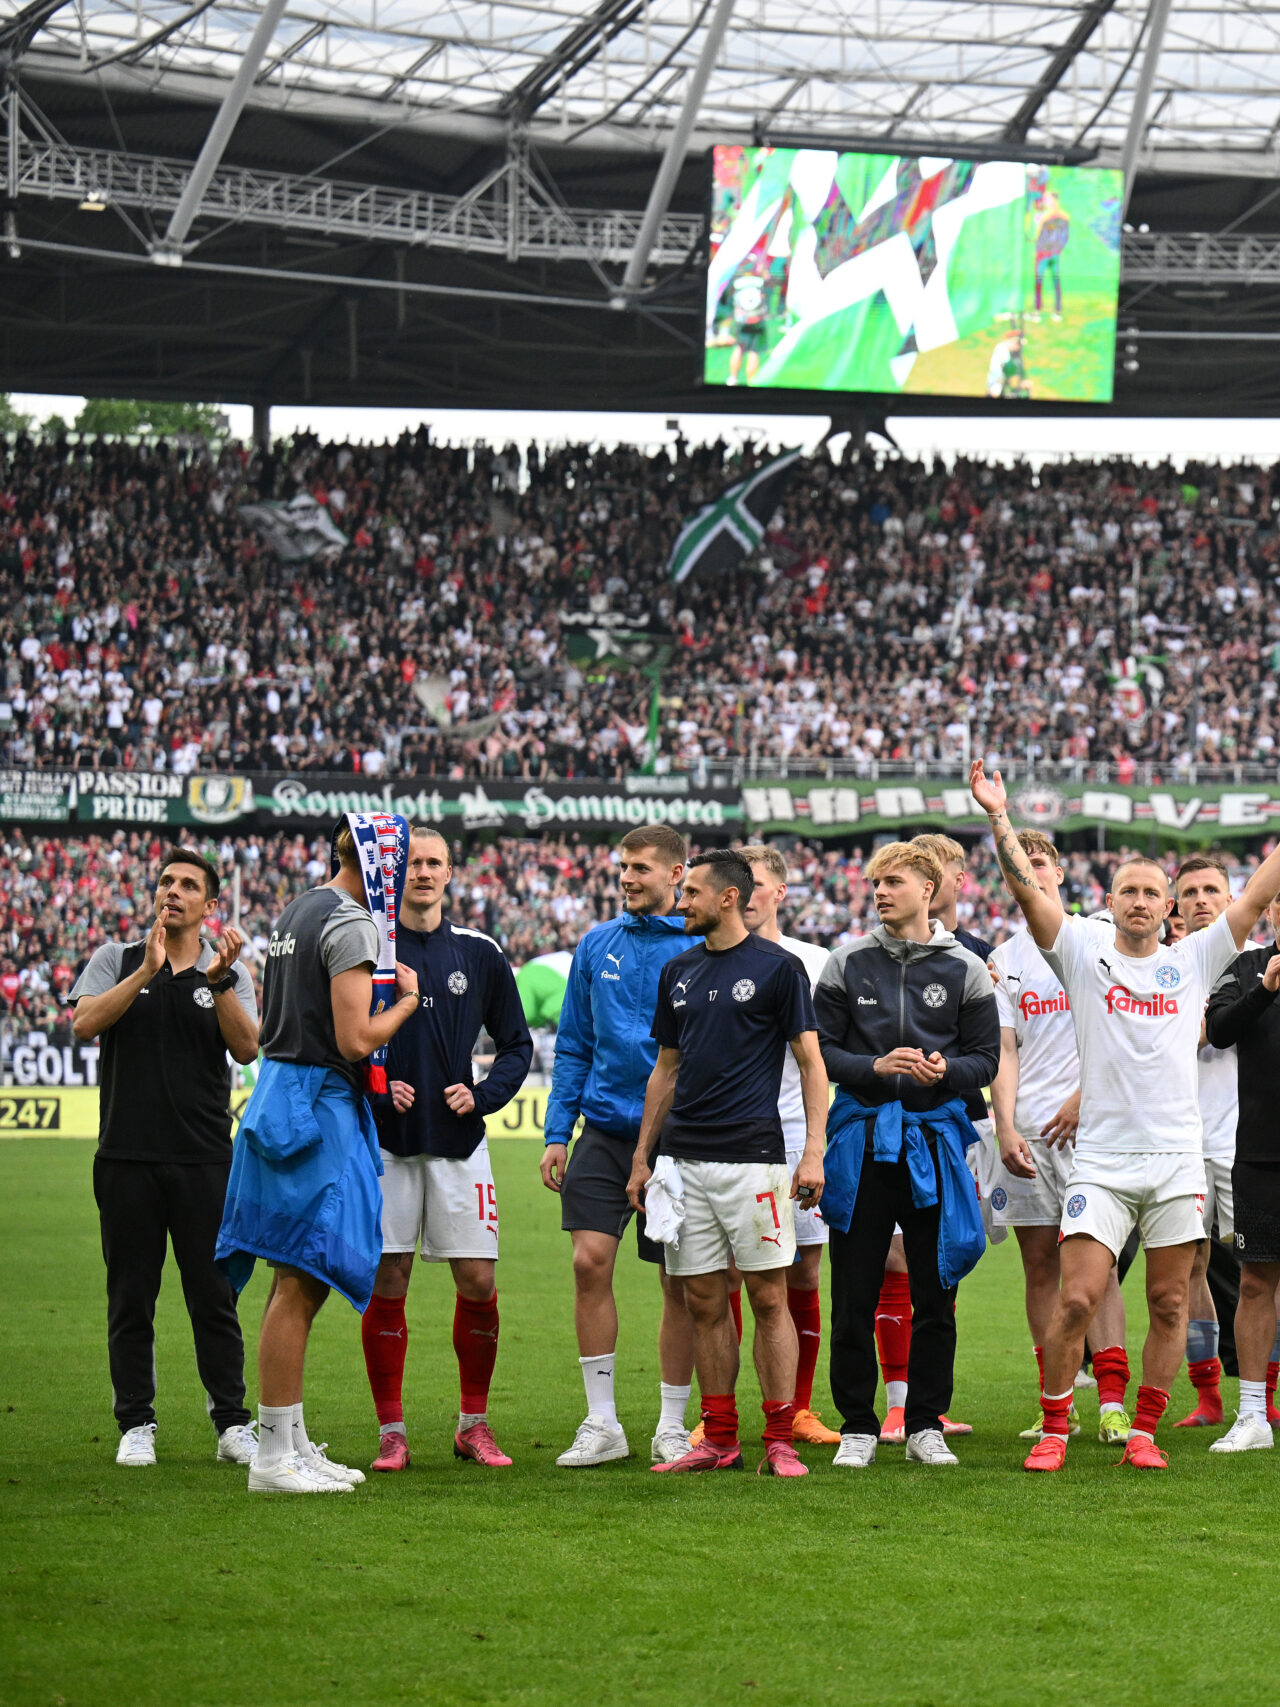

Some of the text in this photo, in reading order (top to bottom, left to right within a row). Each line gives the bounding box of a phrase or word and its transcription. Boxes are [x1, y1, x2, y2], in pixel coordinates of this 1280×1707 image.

[79, 772, 184, 798] PASSION
[93, 795, 169, 822] PRIDE
[422, 996, 434, 1008] 21
[708, 990, 718, 1001] 17
[1018, 990, 1071, 1022] famil
[1105, 985, 1179, 1017] famila
[474, 1183, 498, 1221] 15
[756, 1190, 780, 1229] 7
